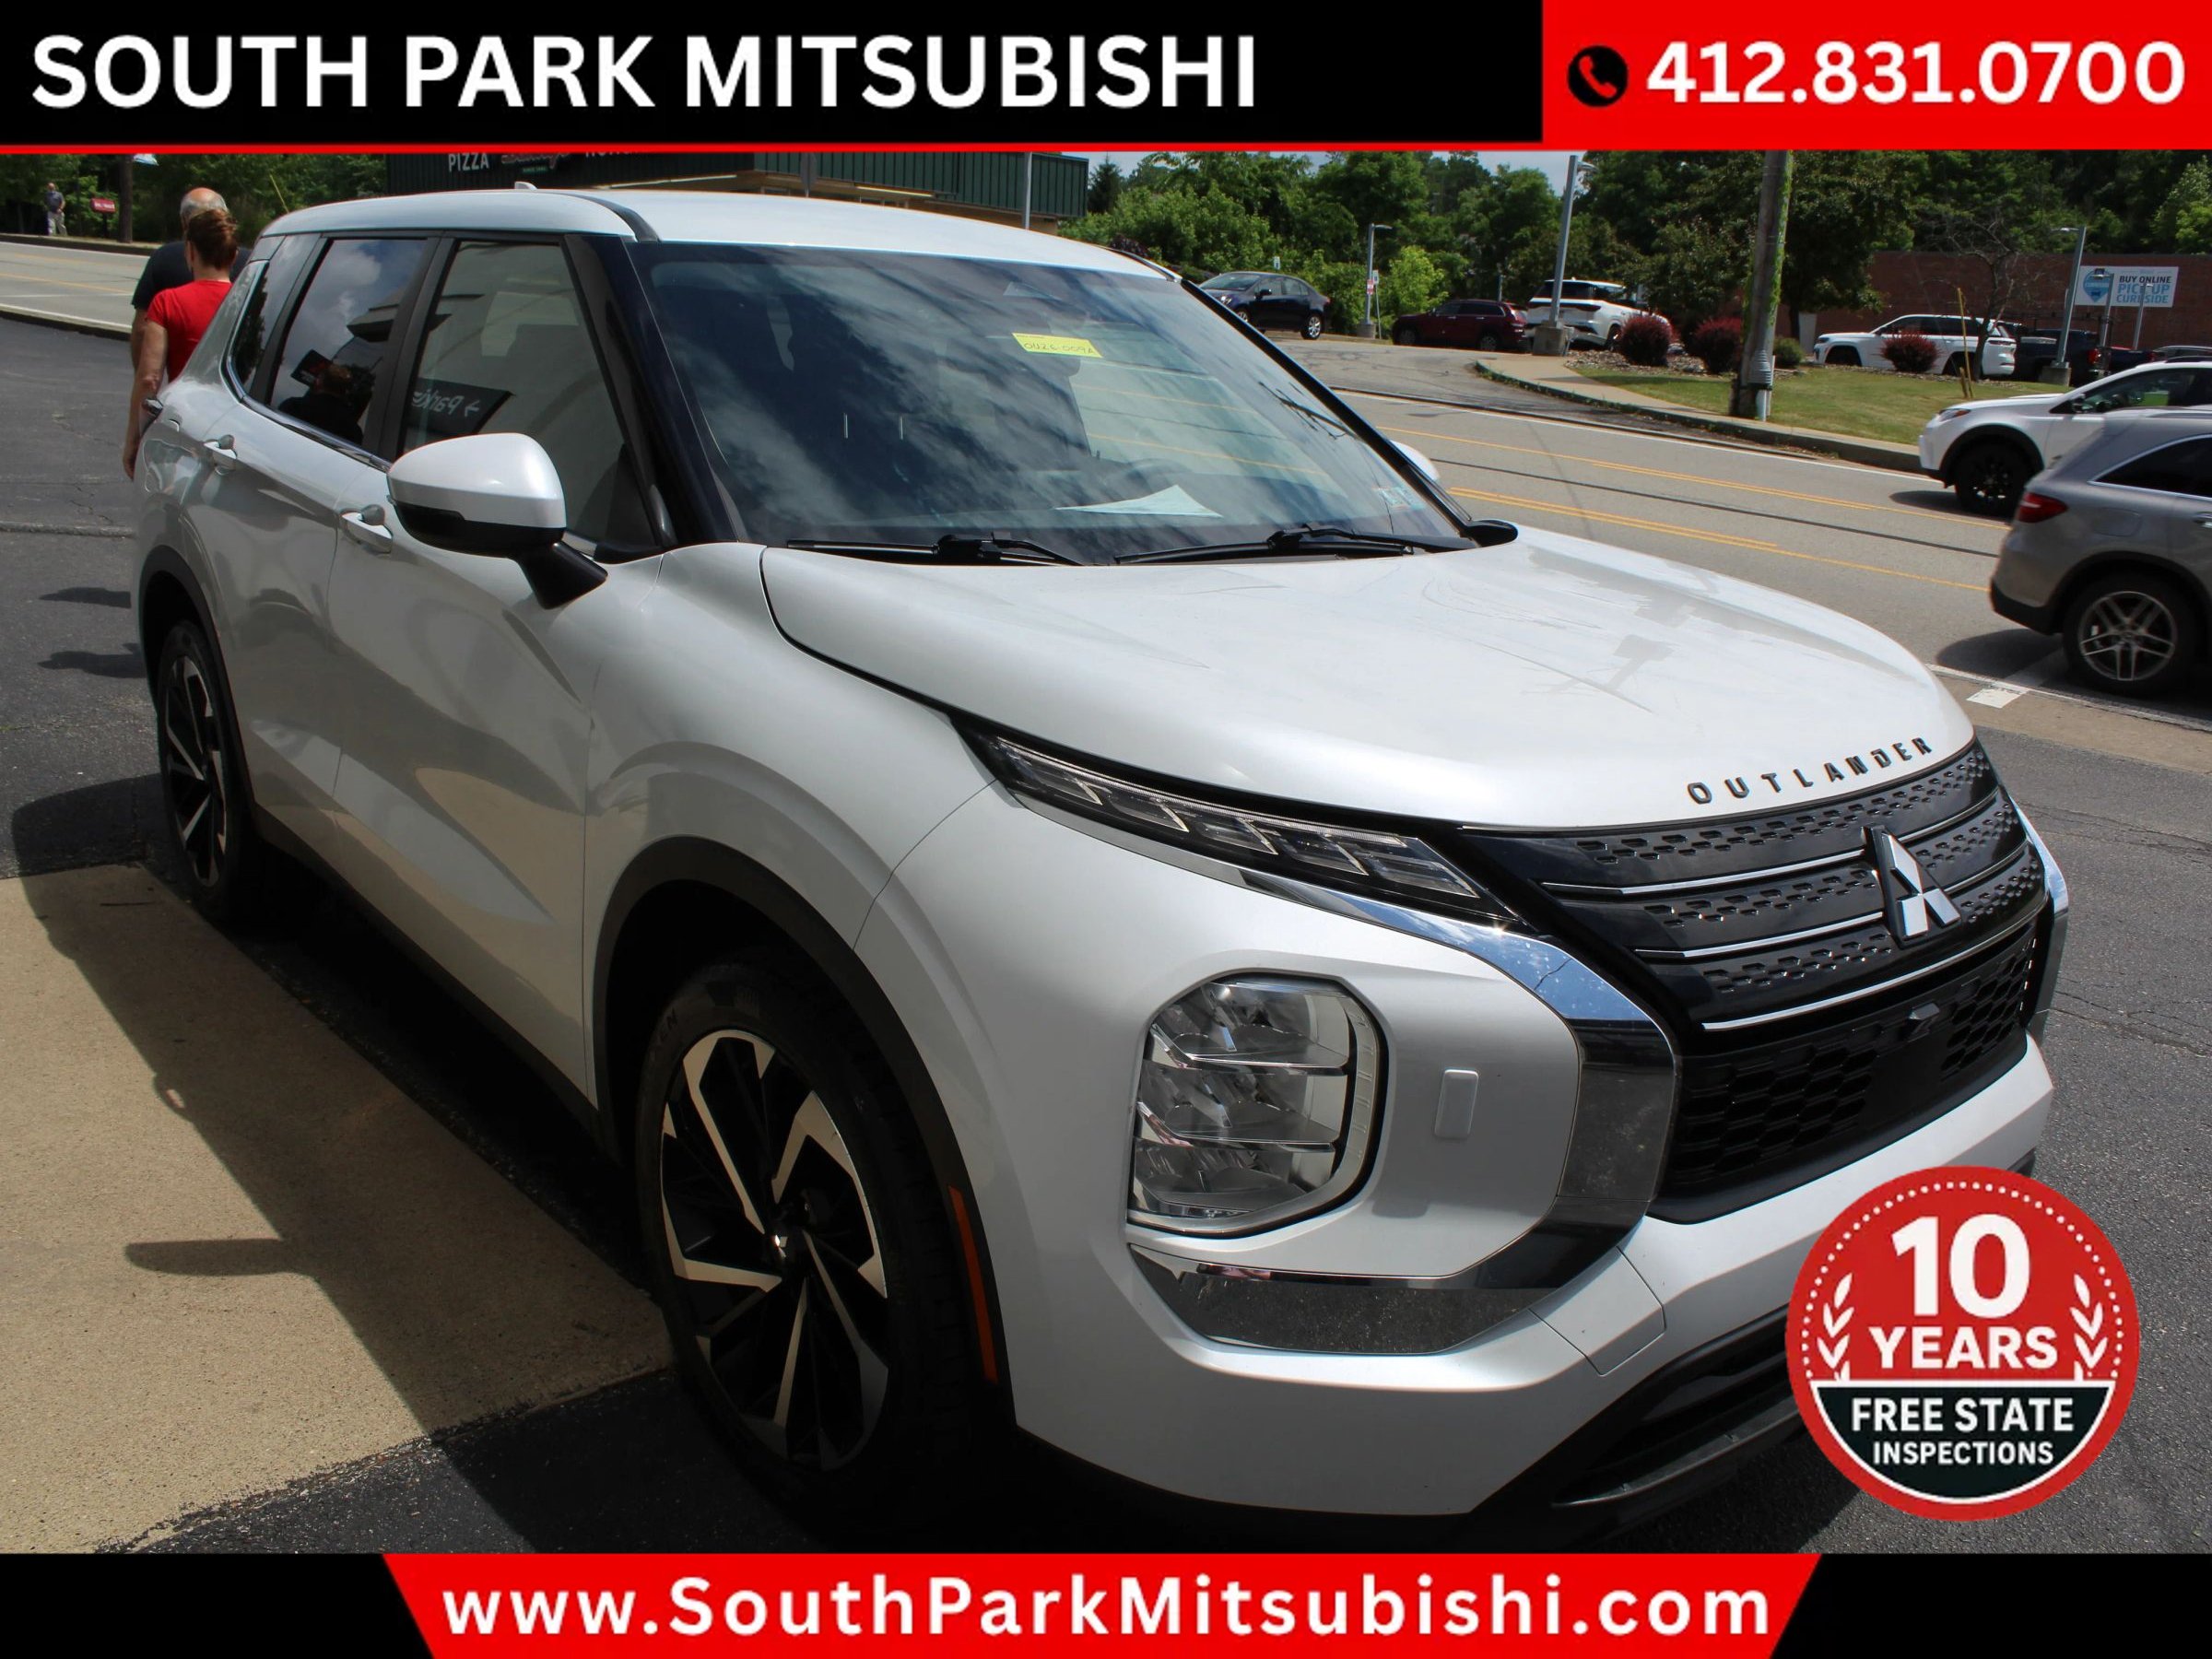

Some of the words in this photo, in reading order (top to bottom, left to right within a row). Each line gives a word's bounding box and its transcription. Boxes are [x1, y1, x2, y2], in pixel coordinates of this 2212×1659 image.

[448, 152, 490, 172] PIZZA
[2119, 276, 2137, 284] BUY
[2139, 276, 2171, 284] ONLINE
[2117, 284, 2146, 295] PIC
[2151, 284, 2171, 295] UP
[1688, 736, 1933, 805] OUTLANDER
